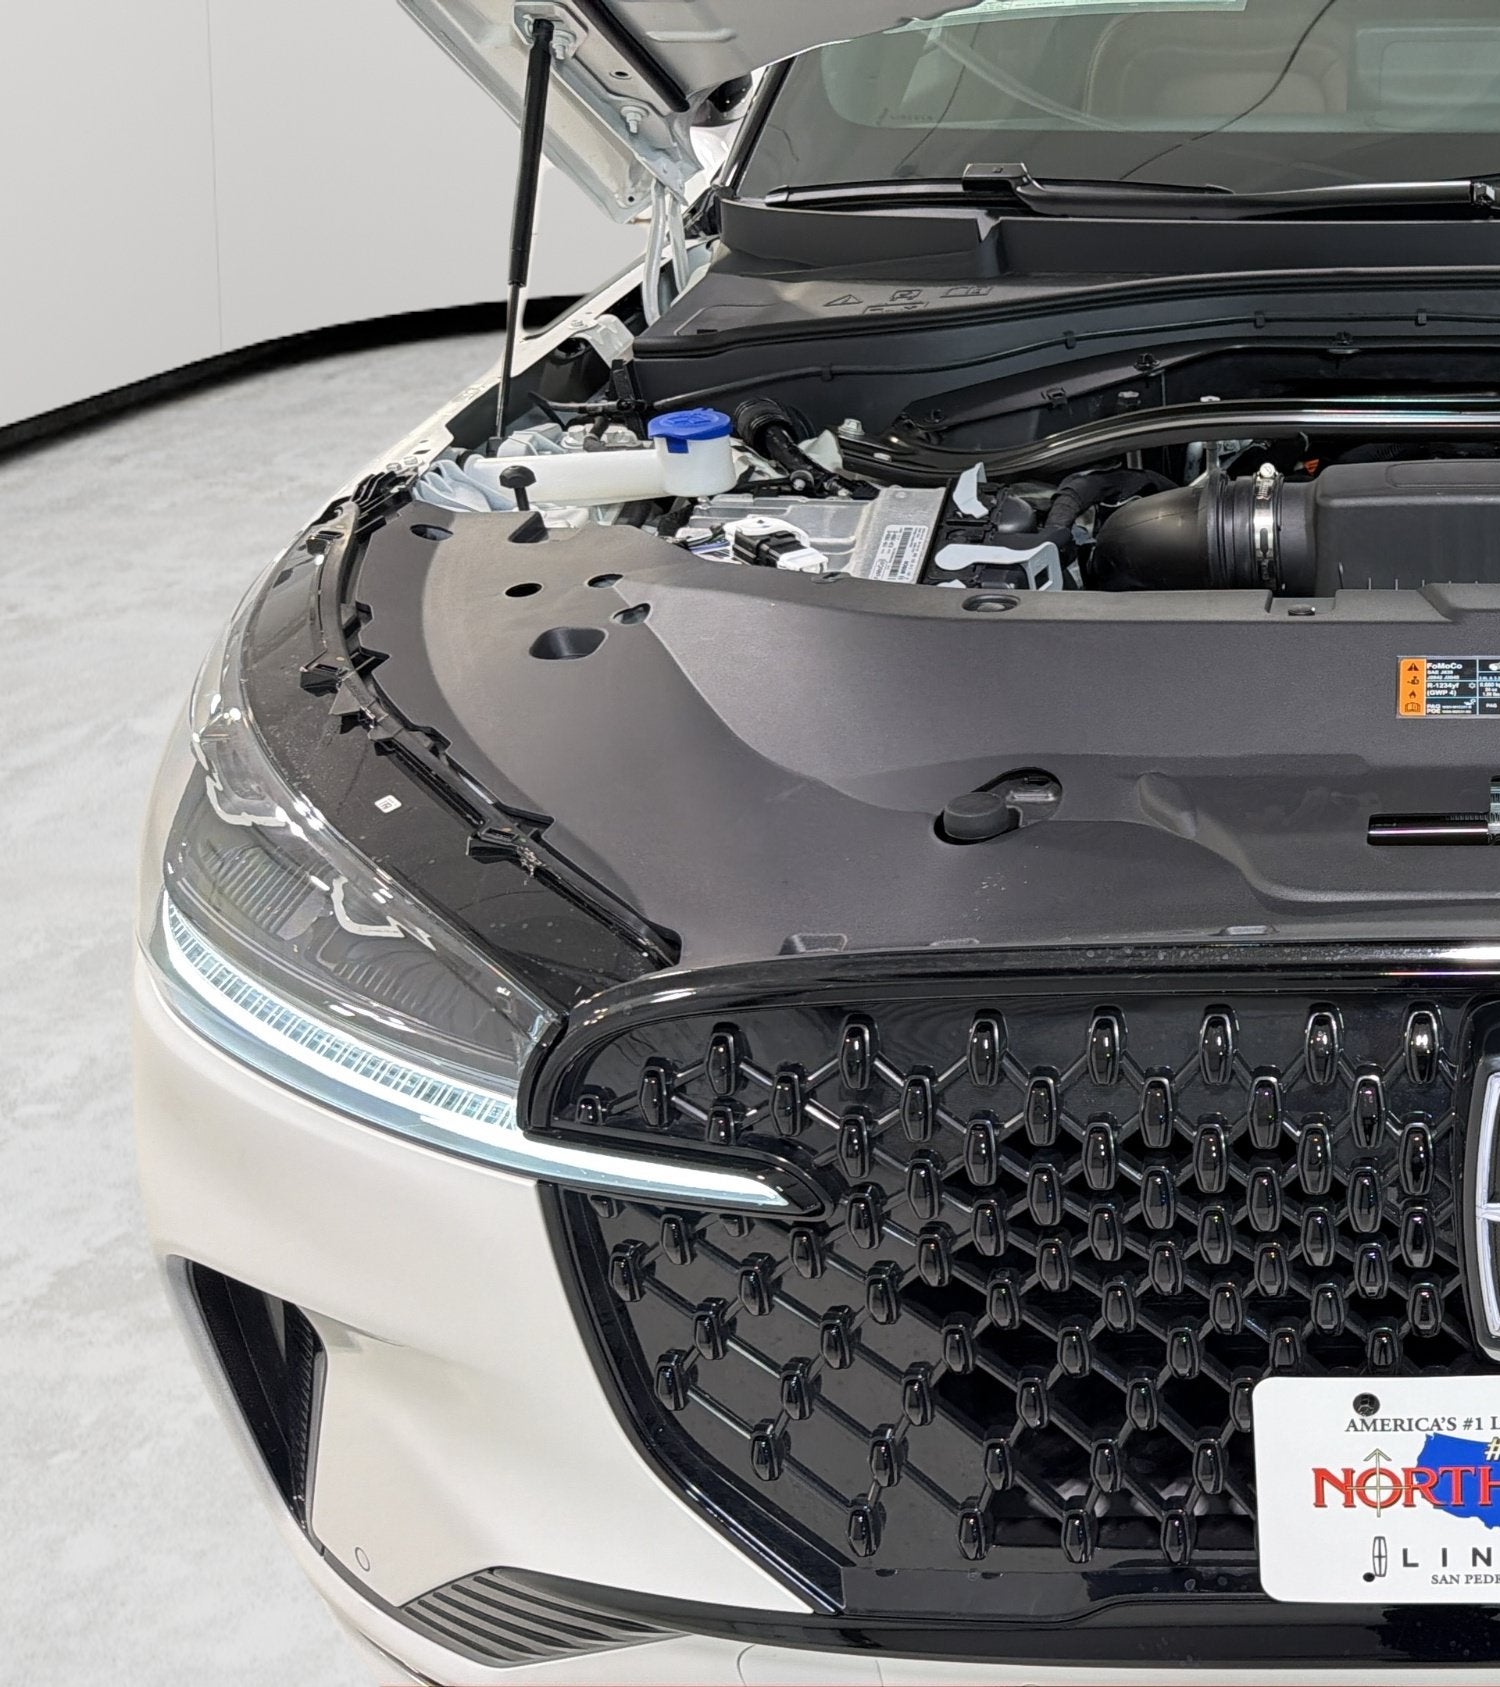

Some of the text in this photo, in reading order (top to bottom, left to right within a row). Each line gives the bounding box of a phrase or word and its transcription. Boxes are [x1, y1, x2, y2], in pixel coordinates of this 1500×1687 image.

[1426, 662, 1463, 670] FoMoCo
[1427, 682, 1460, 690] R-1234yf
[1449, 689, 1457, 697] 4)
[1344, 1415, 1458, 1433] AMERICA'S
[1462, 1415, 1484, 1432] #1
[1431, 1572, 1461, 1585] SAN
